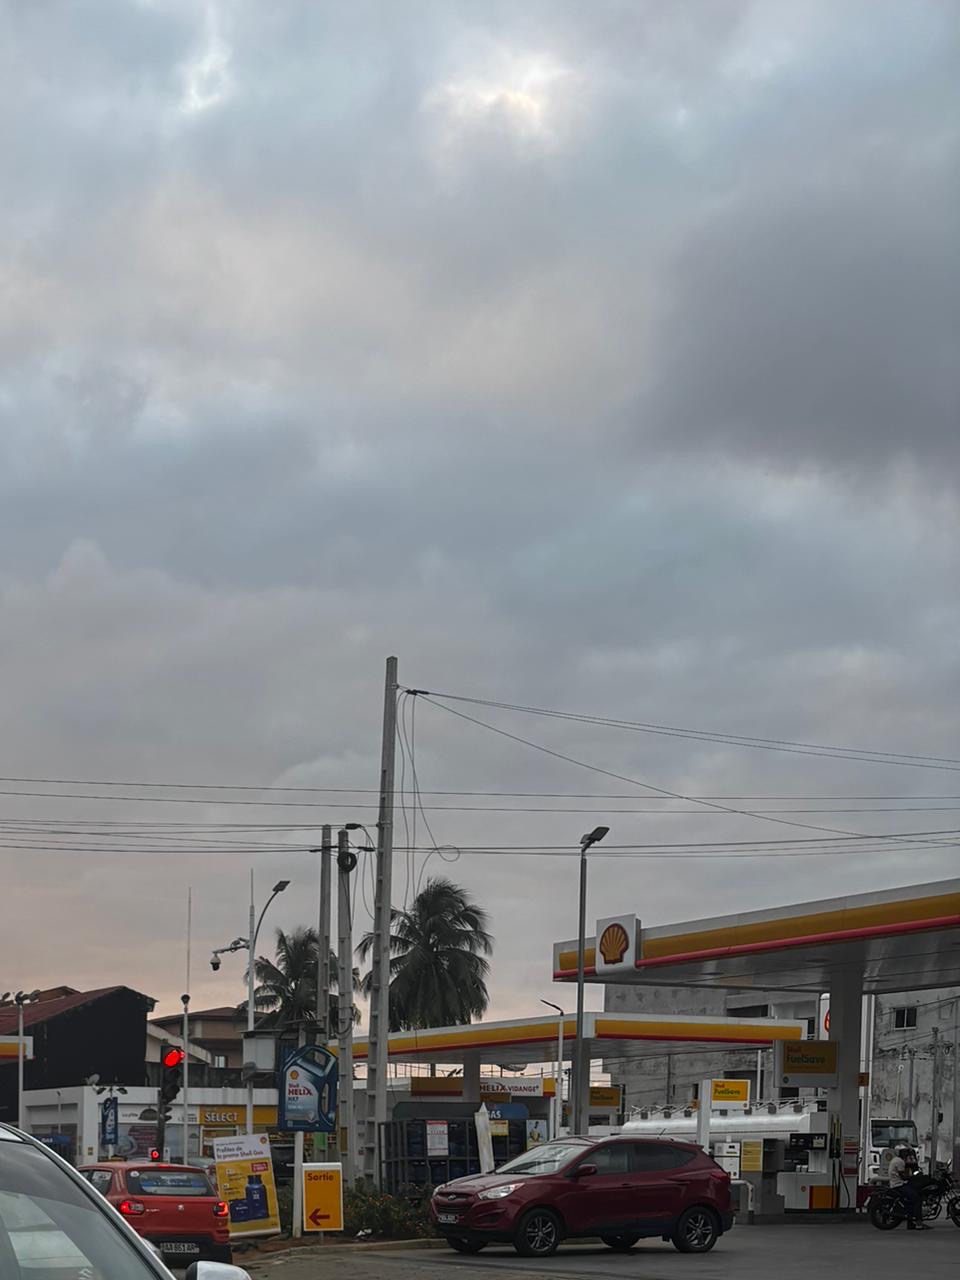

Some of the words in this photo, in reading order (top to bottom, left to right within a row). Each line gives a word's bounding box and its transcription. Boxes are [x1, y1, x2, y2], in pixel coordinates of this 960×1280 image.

[288, 1087, 313, 1096] HELIX
[480, 1083, 507, 1092] HELIX
[205, 1112, 238, 1122] SELECT
[307, 1172, 334, 1182] Sortie
